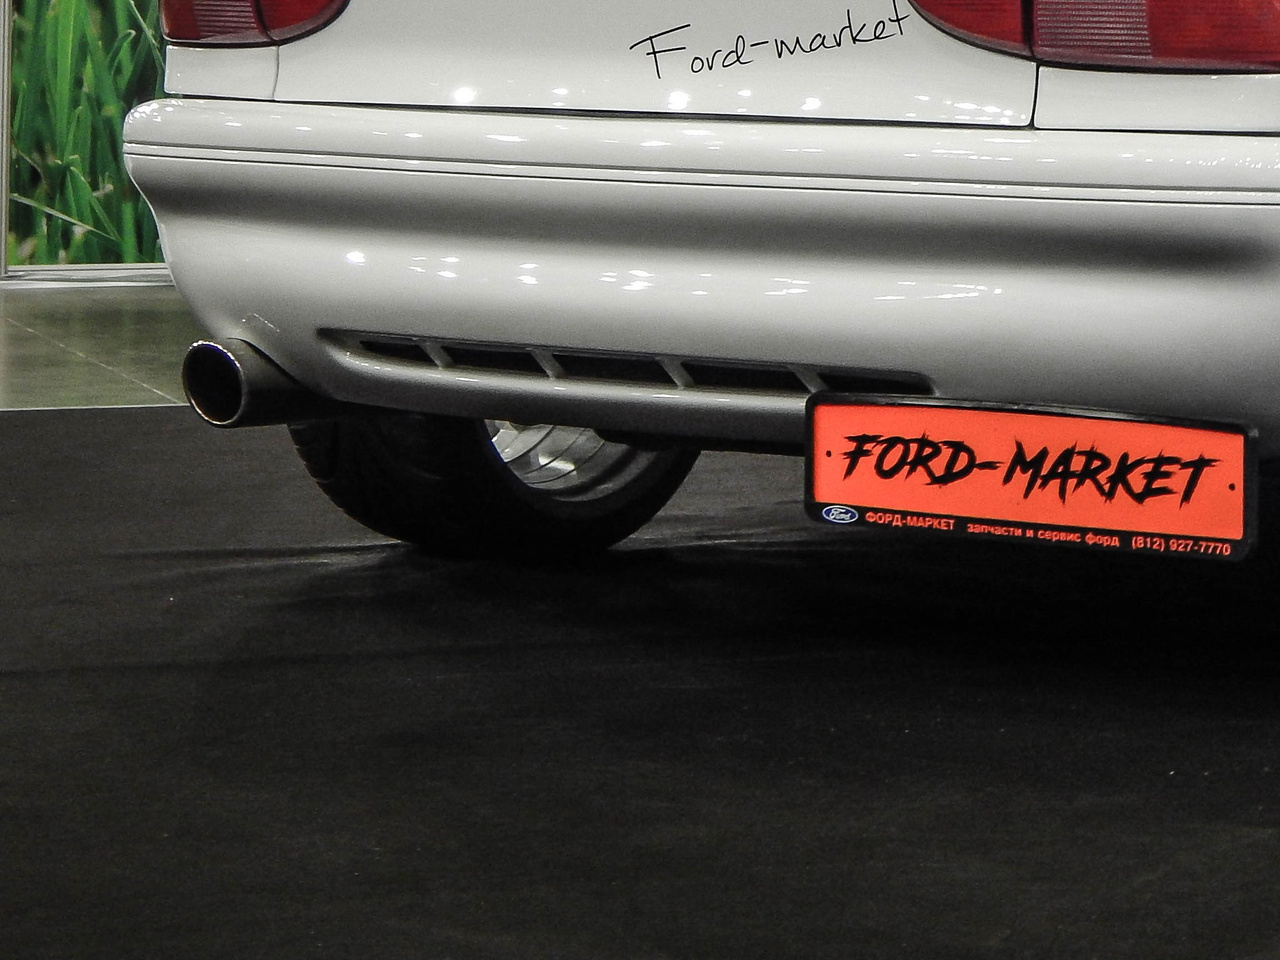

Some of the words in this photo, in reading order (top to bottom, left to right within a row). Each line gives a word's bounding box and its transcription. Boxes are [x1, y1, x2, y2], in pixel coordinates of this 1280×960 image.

[842, 432, 1220, 509] FORD-MARKET
[864, 511, 955, 532] ФОРД-МАРКЕТ
[966, 523, 1023, 538] запчасти
[1026, 527, 1034, 538] и
[1037, 528, 1082, 545] сервис
[1085, 531, 1120, 548] форд
[1131, 536, 1166, 552] (812)
[1170, 539, 1232, 556] 927-7770
